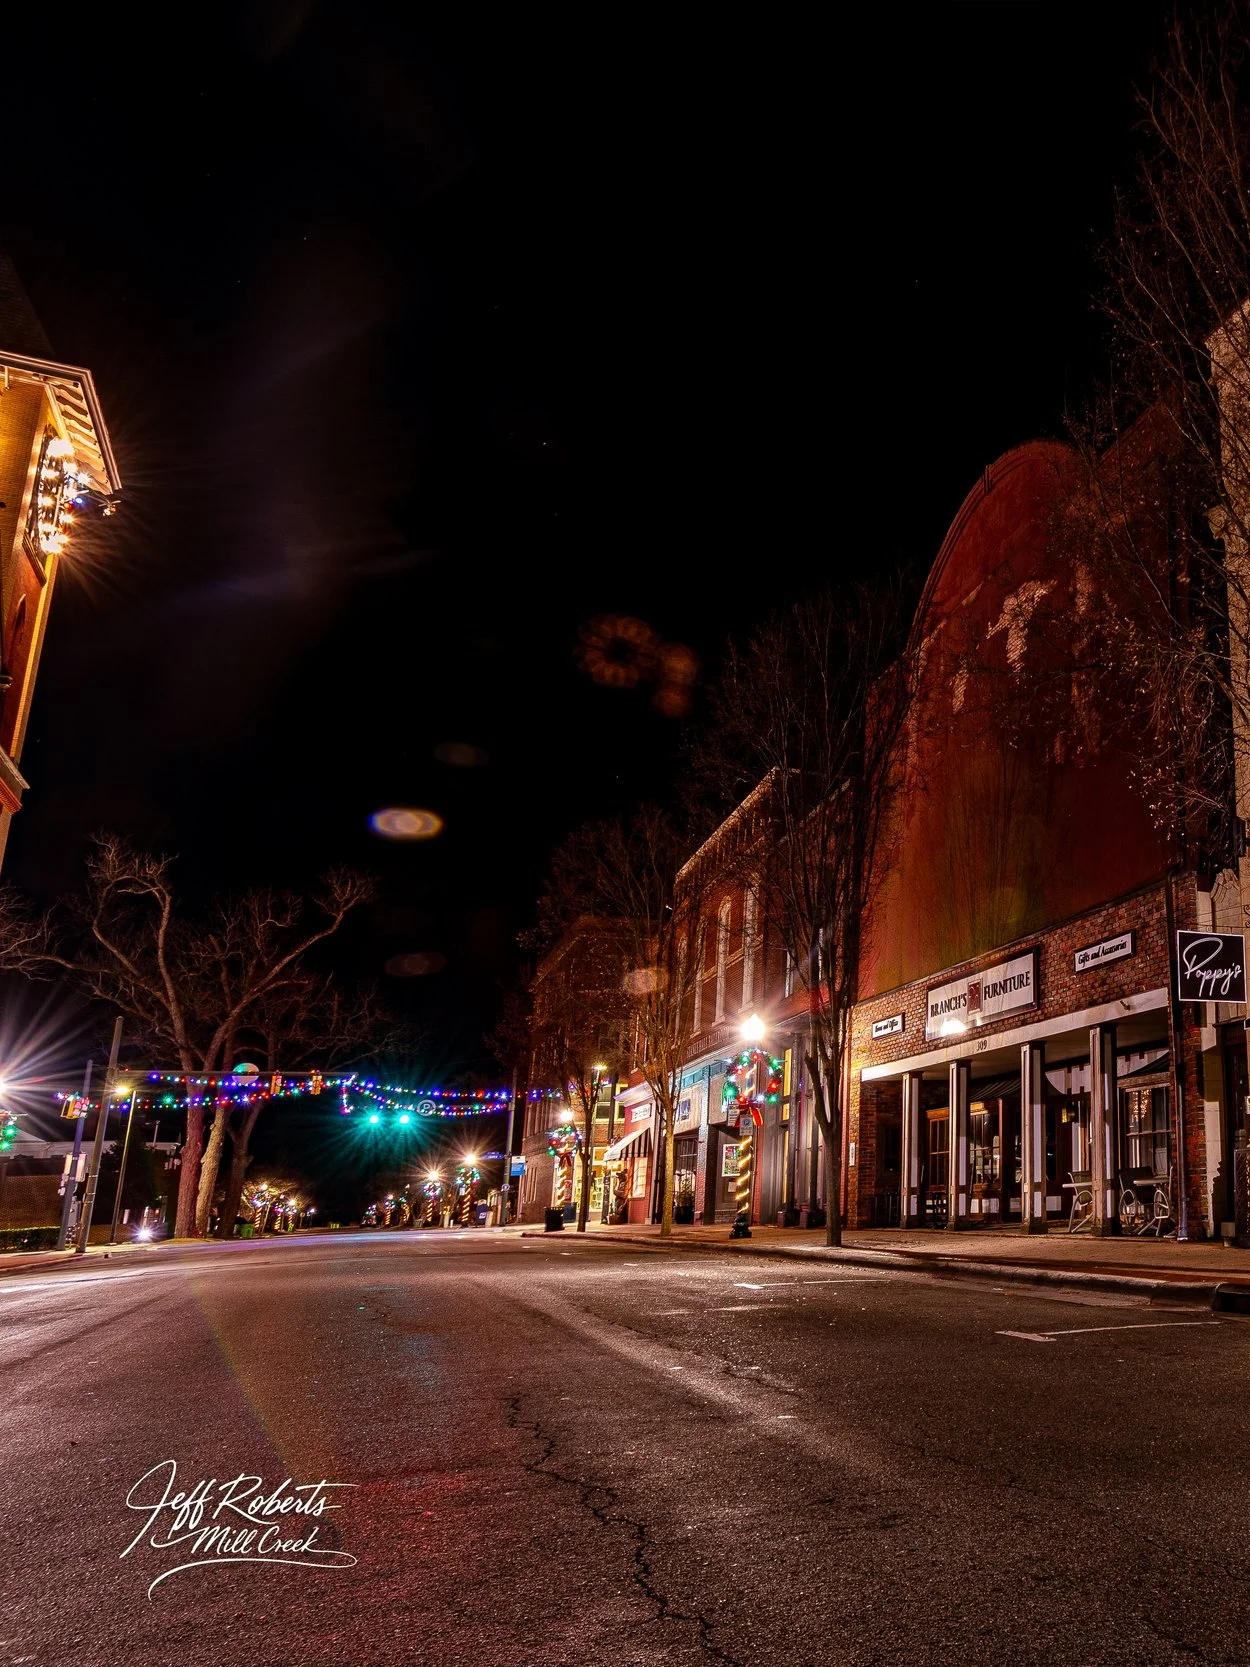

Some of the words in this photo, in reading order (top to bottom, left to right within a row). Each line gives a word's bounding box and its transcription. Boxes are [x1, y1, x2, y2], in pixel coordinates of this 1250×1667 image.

[1182, 937, 1242, 997] Poppy's
[930, 992, 968, 1018] BRANCH'S
[983, 970, 1031, 1001] FURNITURE
[977, 1039, 988, 1052] 309
